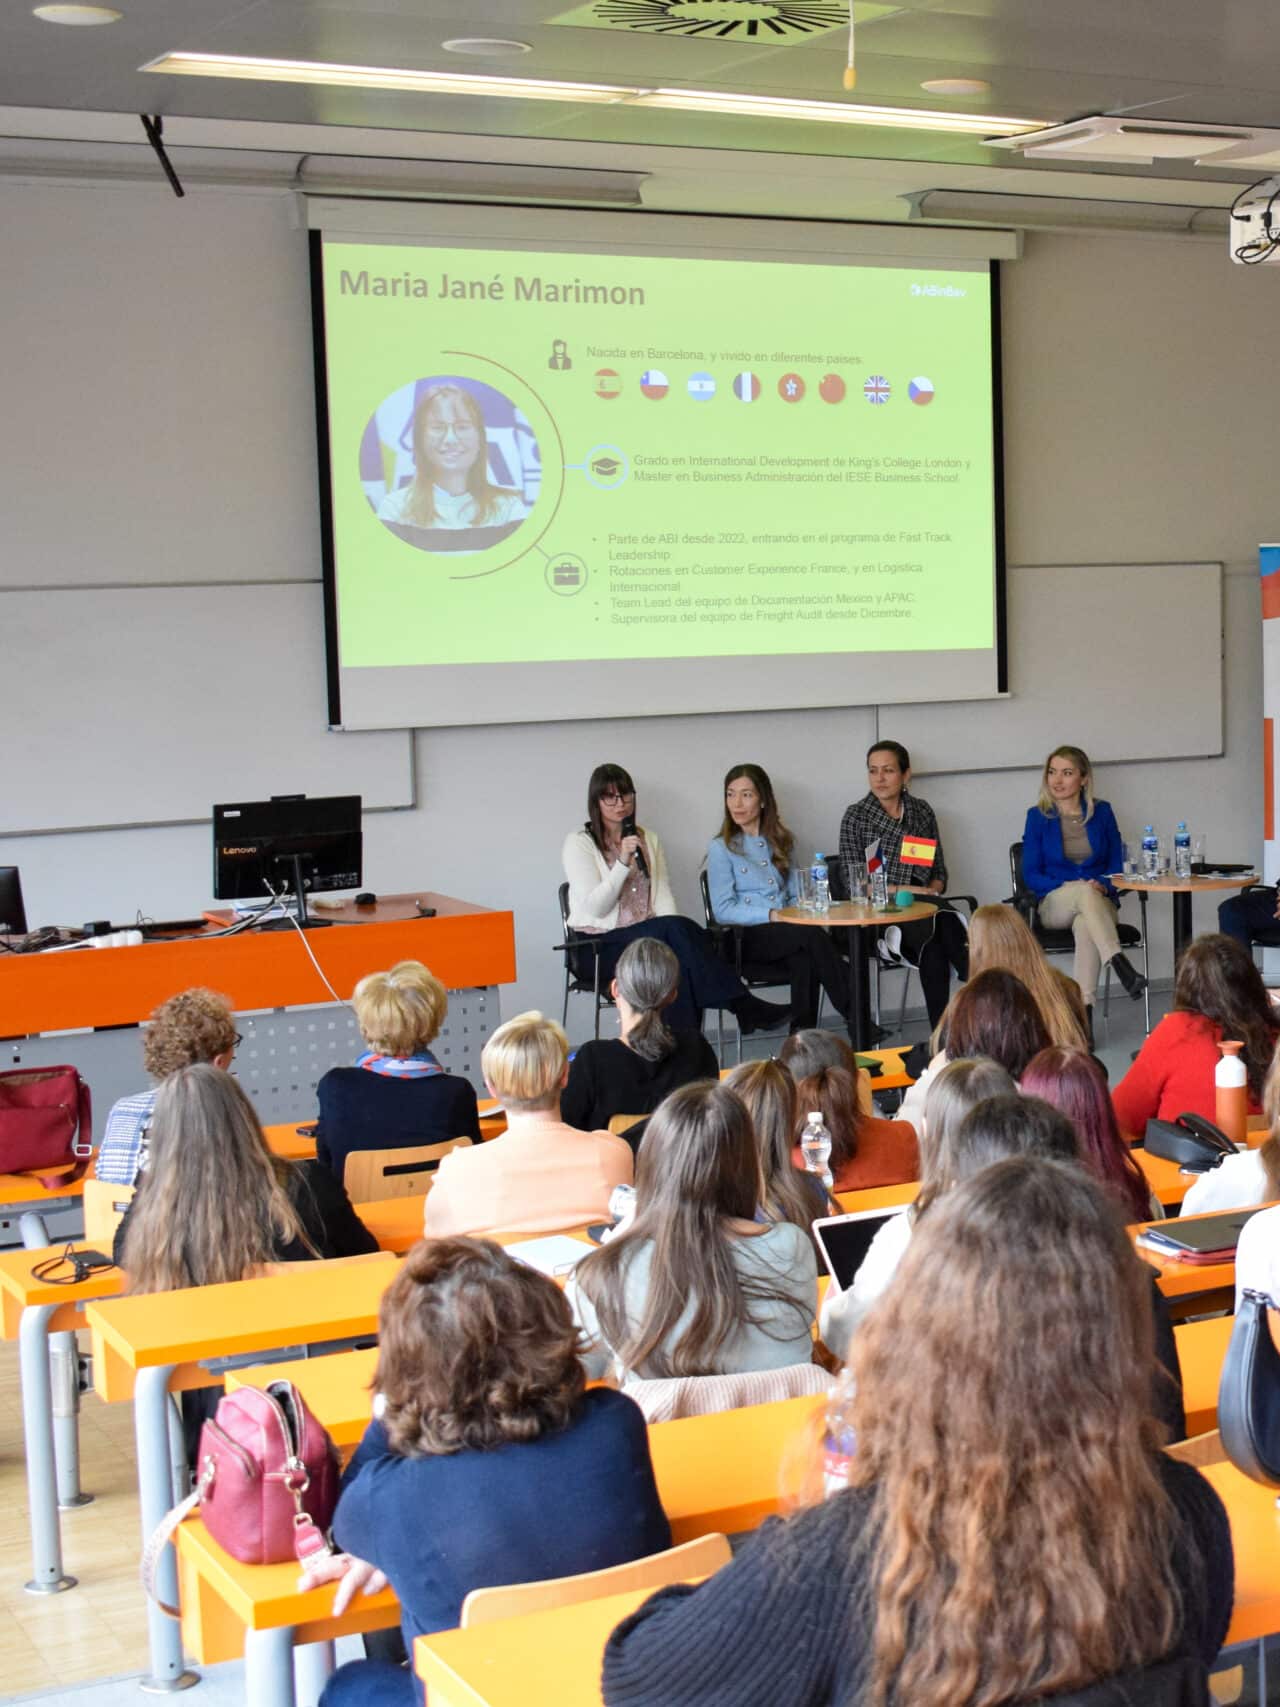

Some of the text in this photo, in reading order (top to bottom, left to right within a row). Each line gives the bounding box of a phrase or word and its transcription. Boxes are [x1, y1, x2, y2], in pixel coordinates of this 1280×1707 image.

[339, 270, 646, 306] Maria Jané Marimon
[586, 346, 626, 359] Nacida
[631, 350, 644, 359] en
[710, 353, 717, 363] y
[720, 351, 751, 361] vivido
[755, 354, 768, 362] en
[771, 352, 823, 364] diferentes
[633, 454, 669, 466] Grado
[672, 457, 685, 466] en
[689, 455, 756, 466] International
[759, 456, 830, 469] Development
[832, 455, 846, 467] de
[883, 457, 922, 469] College
[925, 457, 962, 469] London
[965, 459, 972, 471] y
[633, 470, 672, 482] Master
[675, 473, 689, 482] en
[693, 471, 742, 482] Business
[745, 471, 824, 483] Administración
[826, 471, 842, 483] del
[845, 471, 872, 483] IESE
[875, 472, 921, 483] Business
[608, 533, 640, 545] Parte
[642, 533, 656, 544] de
[658, 533, 678, 544] ABI
[682, 533, 715, 544] desde
[752, 532, 799, 543] entrando
[802, 534, 816, 543] en
[818, 532, 828, 543] el
[831, 533, 881, 545] programa
[883, 531, 896, 543] de
[899, 531, 922, 542] Fast
[924, 531, 952, 542] Track
[609, 565, 672, 577] Rotaciones
[675, 567, 689, 576] en
[691, 564, 745, 575] Customer
[748, 562, 807, 576] Experience
[853, 565, 859, 576] y
[862, 564, 875, 574] en
[610, 597, 641, 608] Team
[644, 596, 671, 607] Lead
[675, 595, 691, 607] del
[694, 597, 731, 609] equipo
[735, 595, 748, 606] de
[752, 594, 833, 605] Documentación
[875, 595, 882, 606] y
[610, 612, 677, 626] Supervisora
[680, 611, 697, 622] del
[699, 612, 736, 625] equipo
[740, 610, 753, 622] de
[756, 610, 794, 623] Freight
[796, 609, 822, 620] Audit
[825, 608, 857, 620] desde
[223, 846, 257, 855] Lenovo
